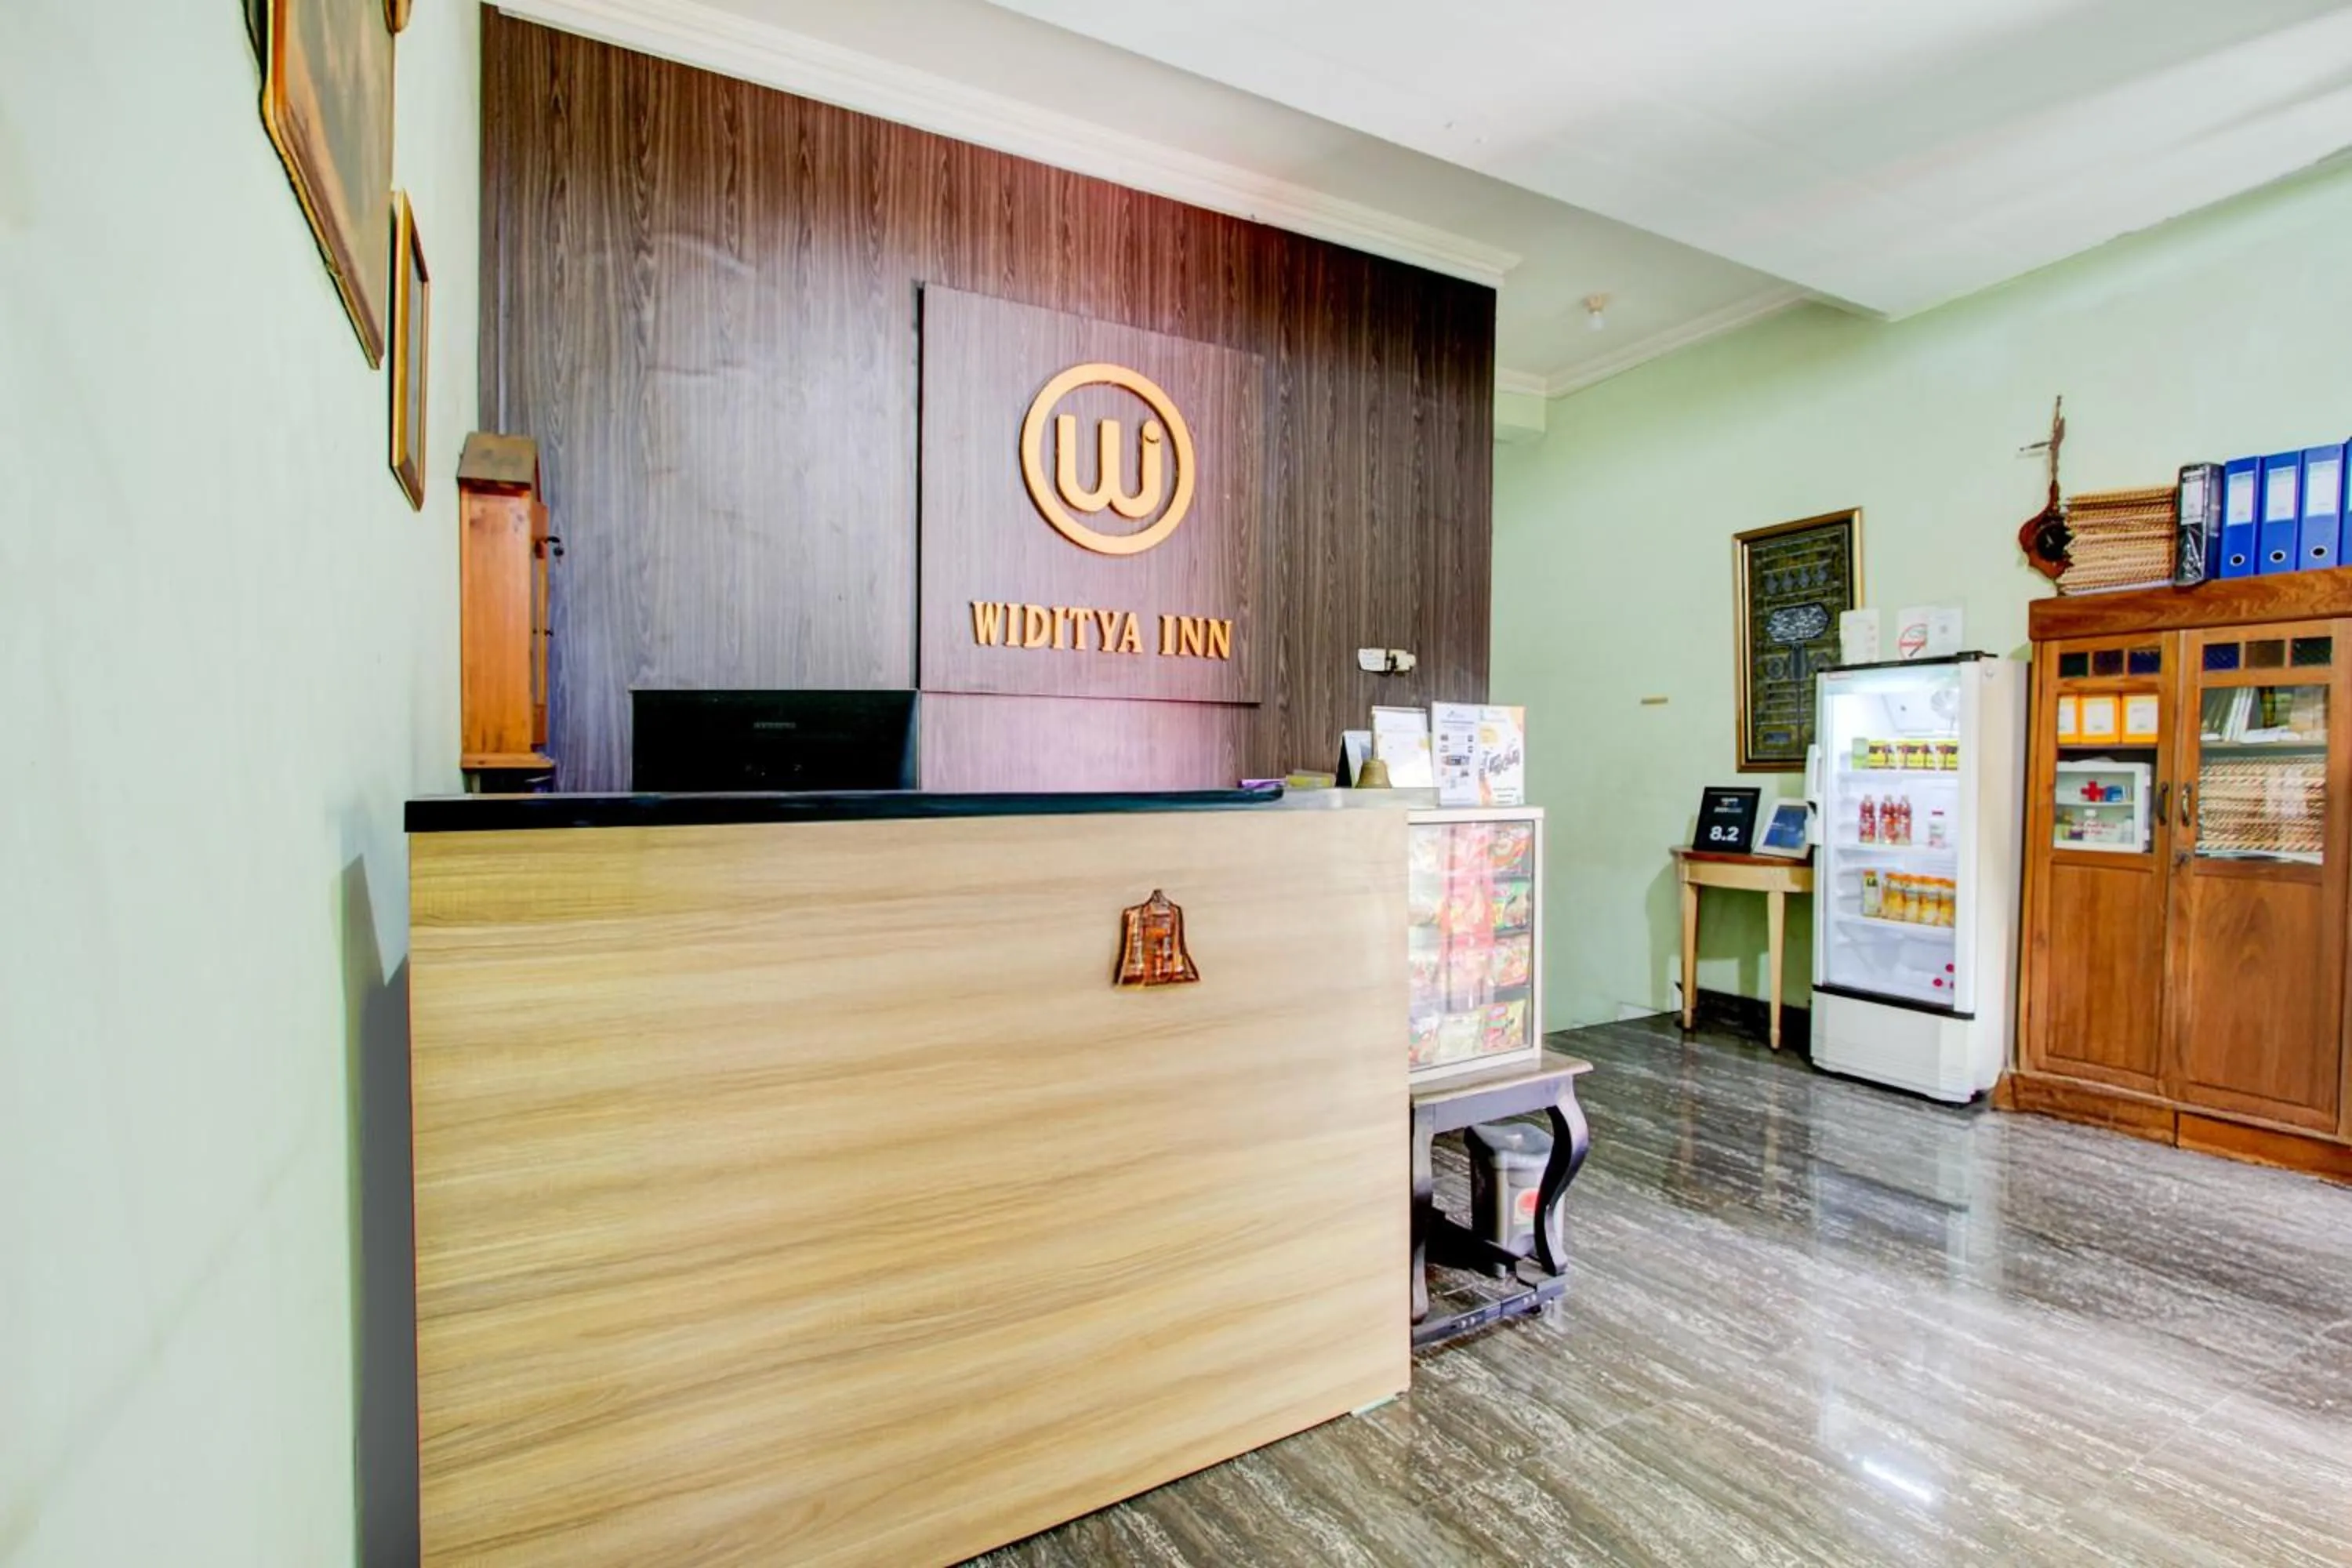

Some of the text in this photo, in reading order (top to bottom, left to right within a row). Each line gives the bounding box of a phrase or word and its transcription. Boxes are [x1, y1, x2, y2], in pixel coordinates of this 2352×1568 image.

[971, 600, 1232, 660] WIDITYA INN
[1709, 826, 1739, 841] 8.2
